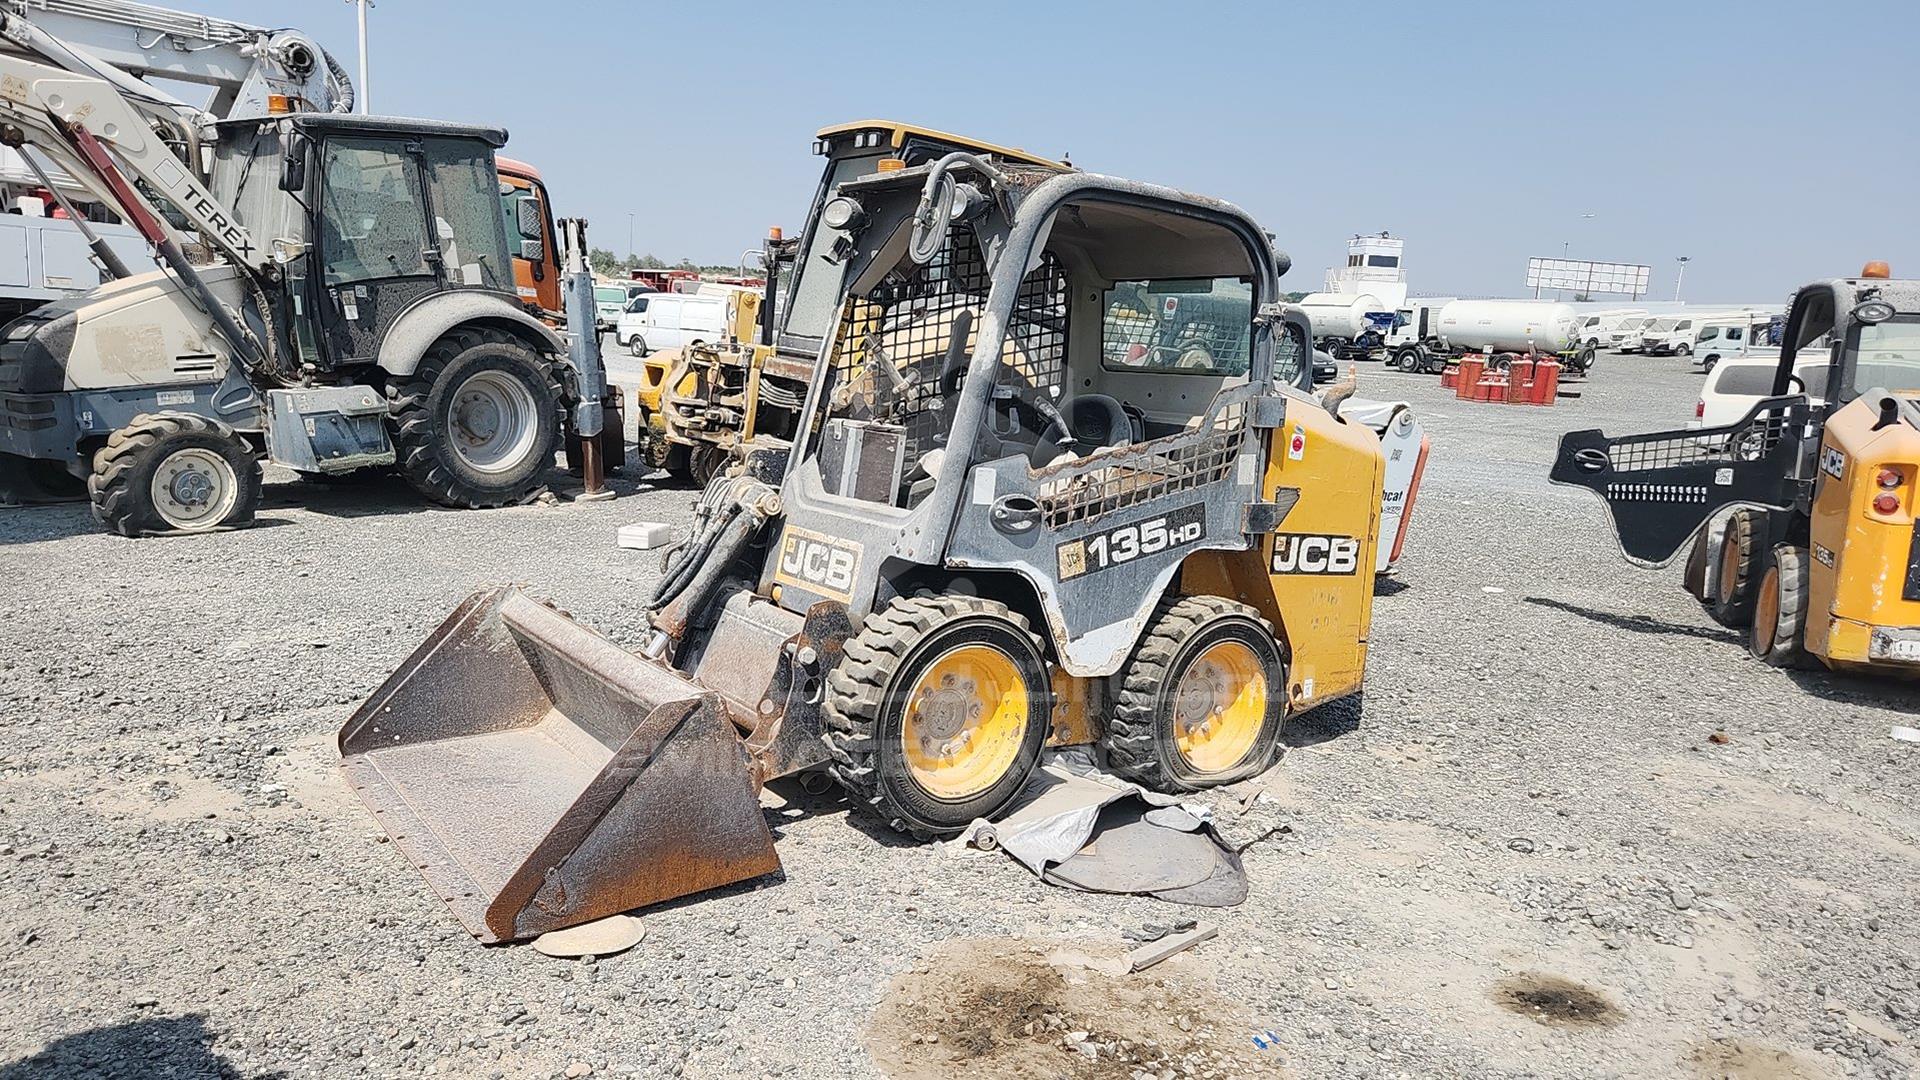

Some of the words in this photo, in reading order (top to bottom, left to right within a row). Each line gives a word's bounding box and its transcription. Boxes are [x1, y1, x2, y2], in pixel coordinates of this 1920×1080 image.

[184, 184, 256, 260] TEREX
[1821, 447, 1845, 478] JCB
[783, 540, 855, 590] JCB
[1088, 518, 1201, 567] 135HD
[1273, 537, 1357, 573] JCB
